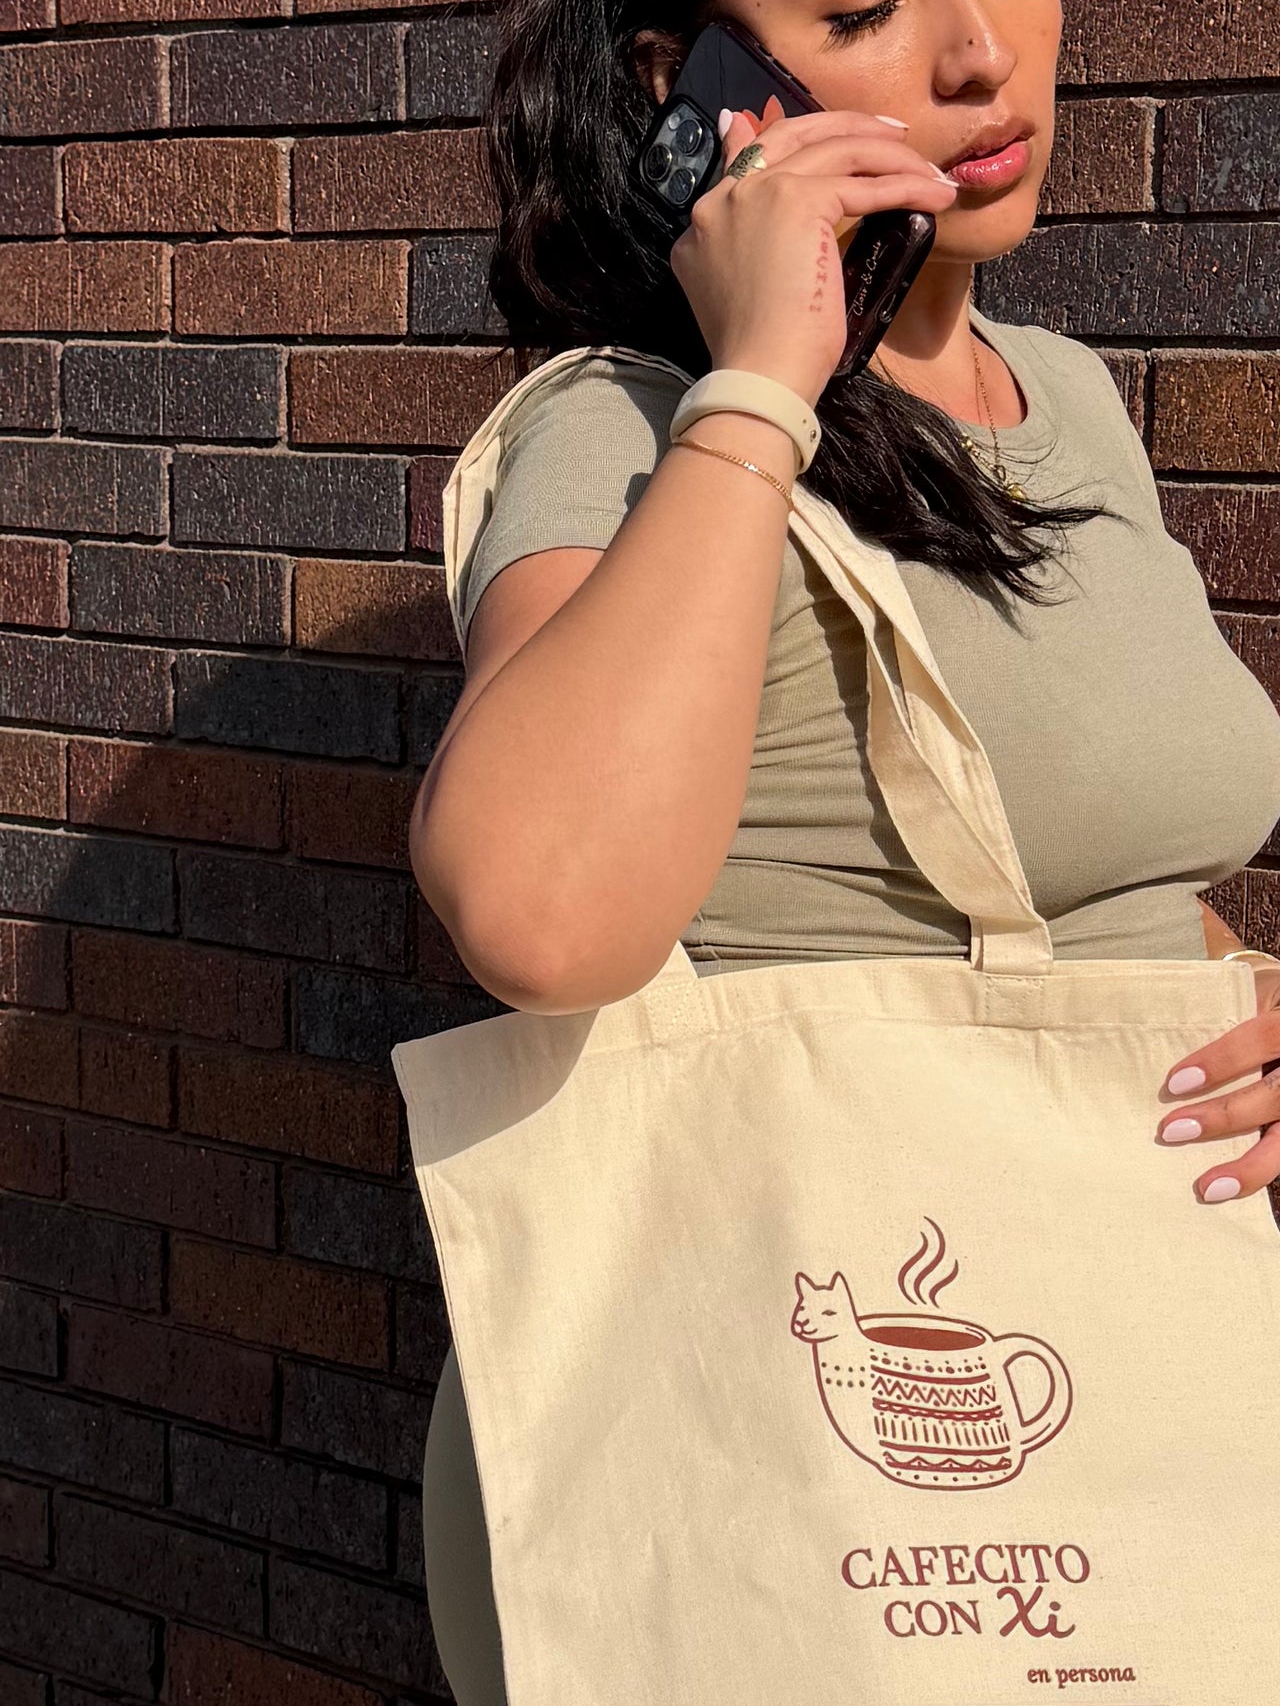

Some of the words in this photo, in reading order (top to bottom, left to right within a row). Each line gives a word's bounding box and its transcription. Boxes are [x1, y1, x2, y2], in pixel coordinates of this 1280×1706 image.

[840, 1543, 1091, 1589] CAFECITO
[883, 1599, 983, 1638] CON
[996, 1585, 1076, 1639] Xi
[1026, 1667, 1052, 1685] en
[1055, 1665, 1137, 1689] persona
